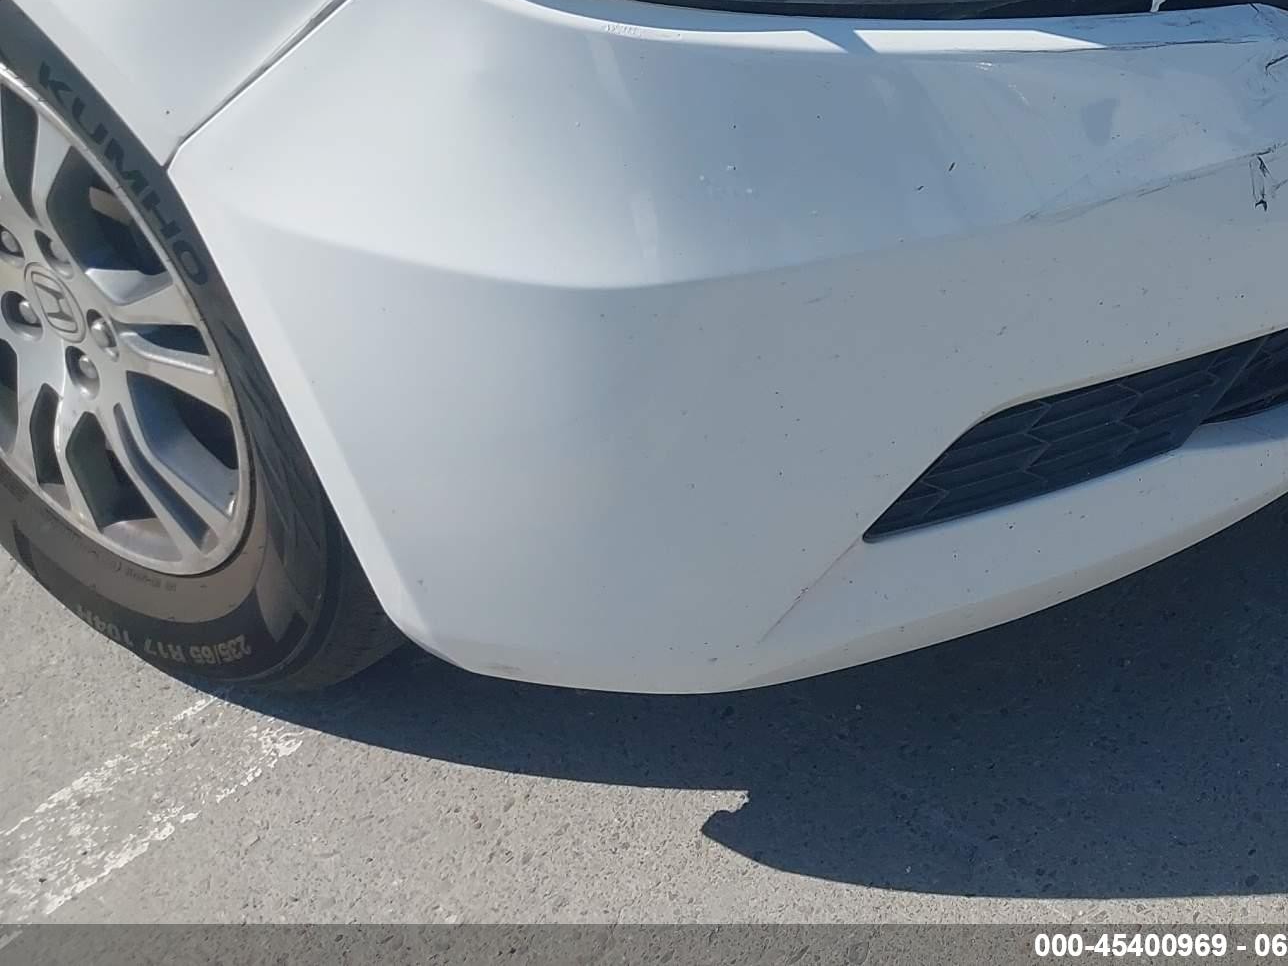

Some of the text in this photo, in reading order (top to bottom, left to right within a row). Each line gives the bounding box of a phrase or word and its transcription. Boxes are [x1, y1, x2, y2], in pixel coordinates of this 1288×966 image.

[39, 61, 208, 284] KUMHO
[143, 638, 187, 662] R17
[189, 634, 252, 664] 235/65
